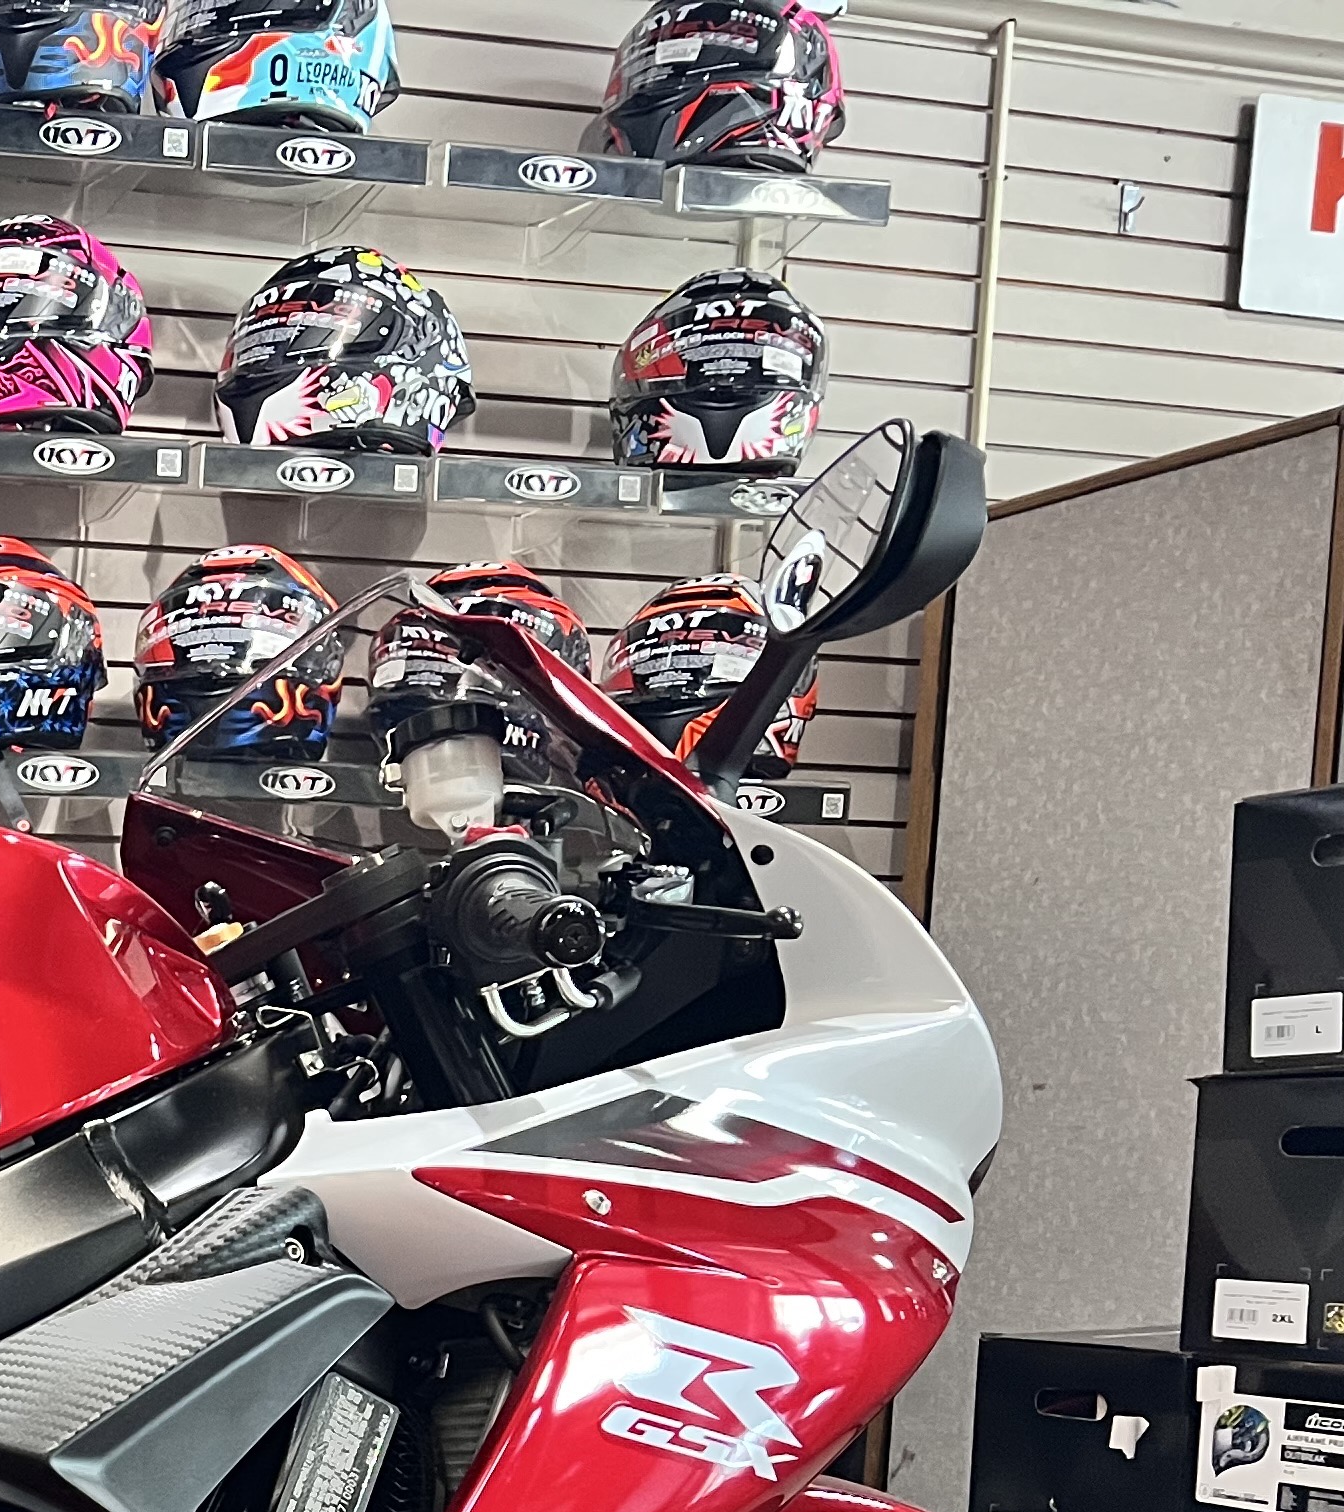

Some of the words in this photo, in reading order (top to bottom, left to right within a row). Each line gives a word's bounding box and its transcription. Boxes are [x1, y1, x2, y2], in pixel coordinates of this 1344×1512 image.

[297, 61, 356, 88] LEOPARD
[1314, 1025, 1323, 1035] L
[1271, 1312, 1295, 1326] 2XL
